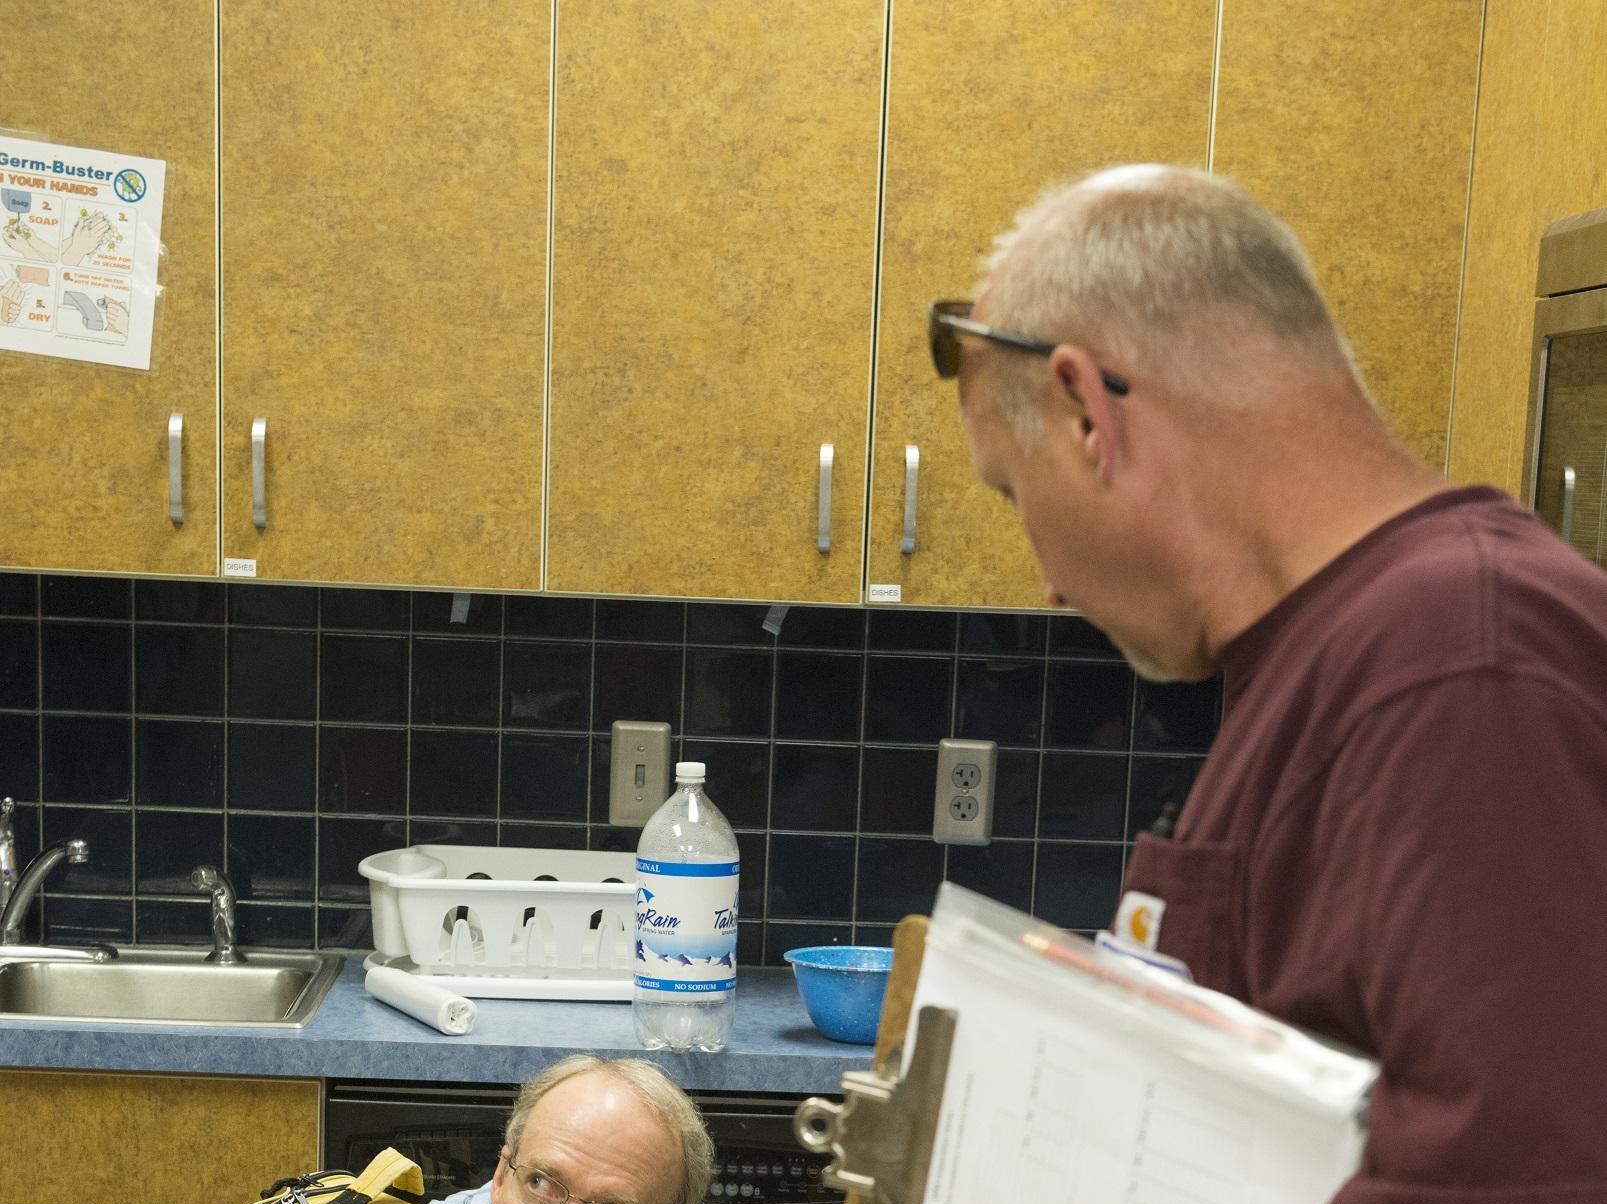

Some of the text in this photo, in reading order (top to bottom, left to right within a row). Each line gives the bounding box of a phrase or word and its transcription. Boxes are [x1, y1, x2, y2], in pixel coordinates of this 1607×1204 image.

[0, 152, 113, 181] Germ-Buster
[8, 174, 46, 189] YOUR
[49, 180, 98, 197] HANDS
[28, 215, 59, 225] SOAP
[28, 312, 51, 322] DRY
[226, 563, 254, 572] DISHES
[675, 983, 717, 991] NO SODIUM
